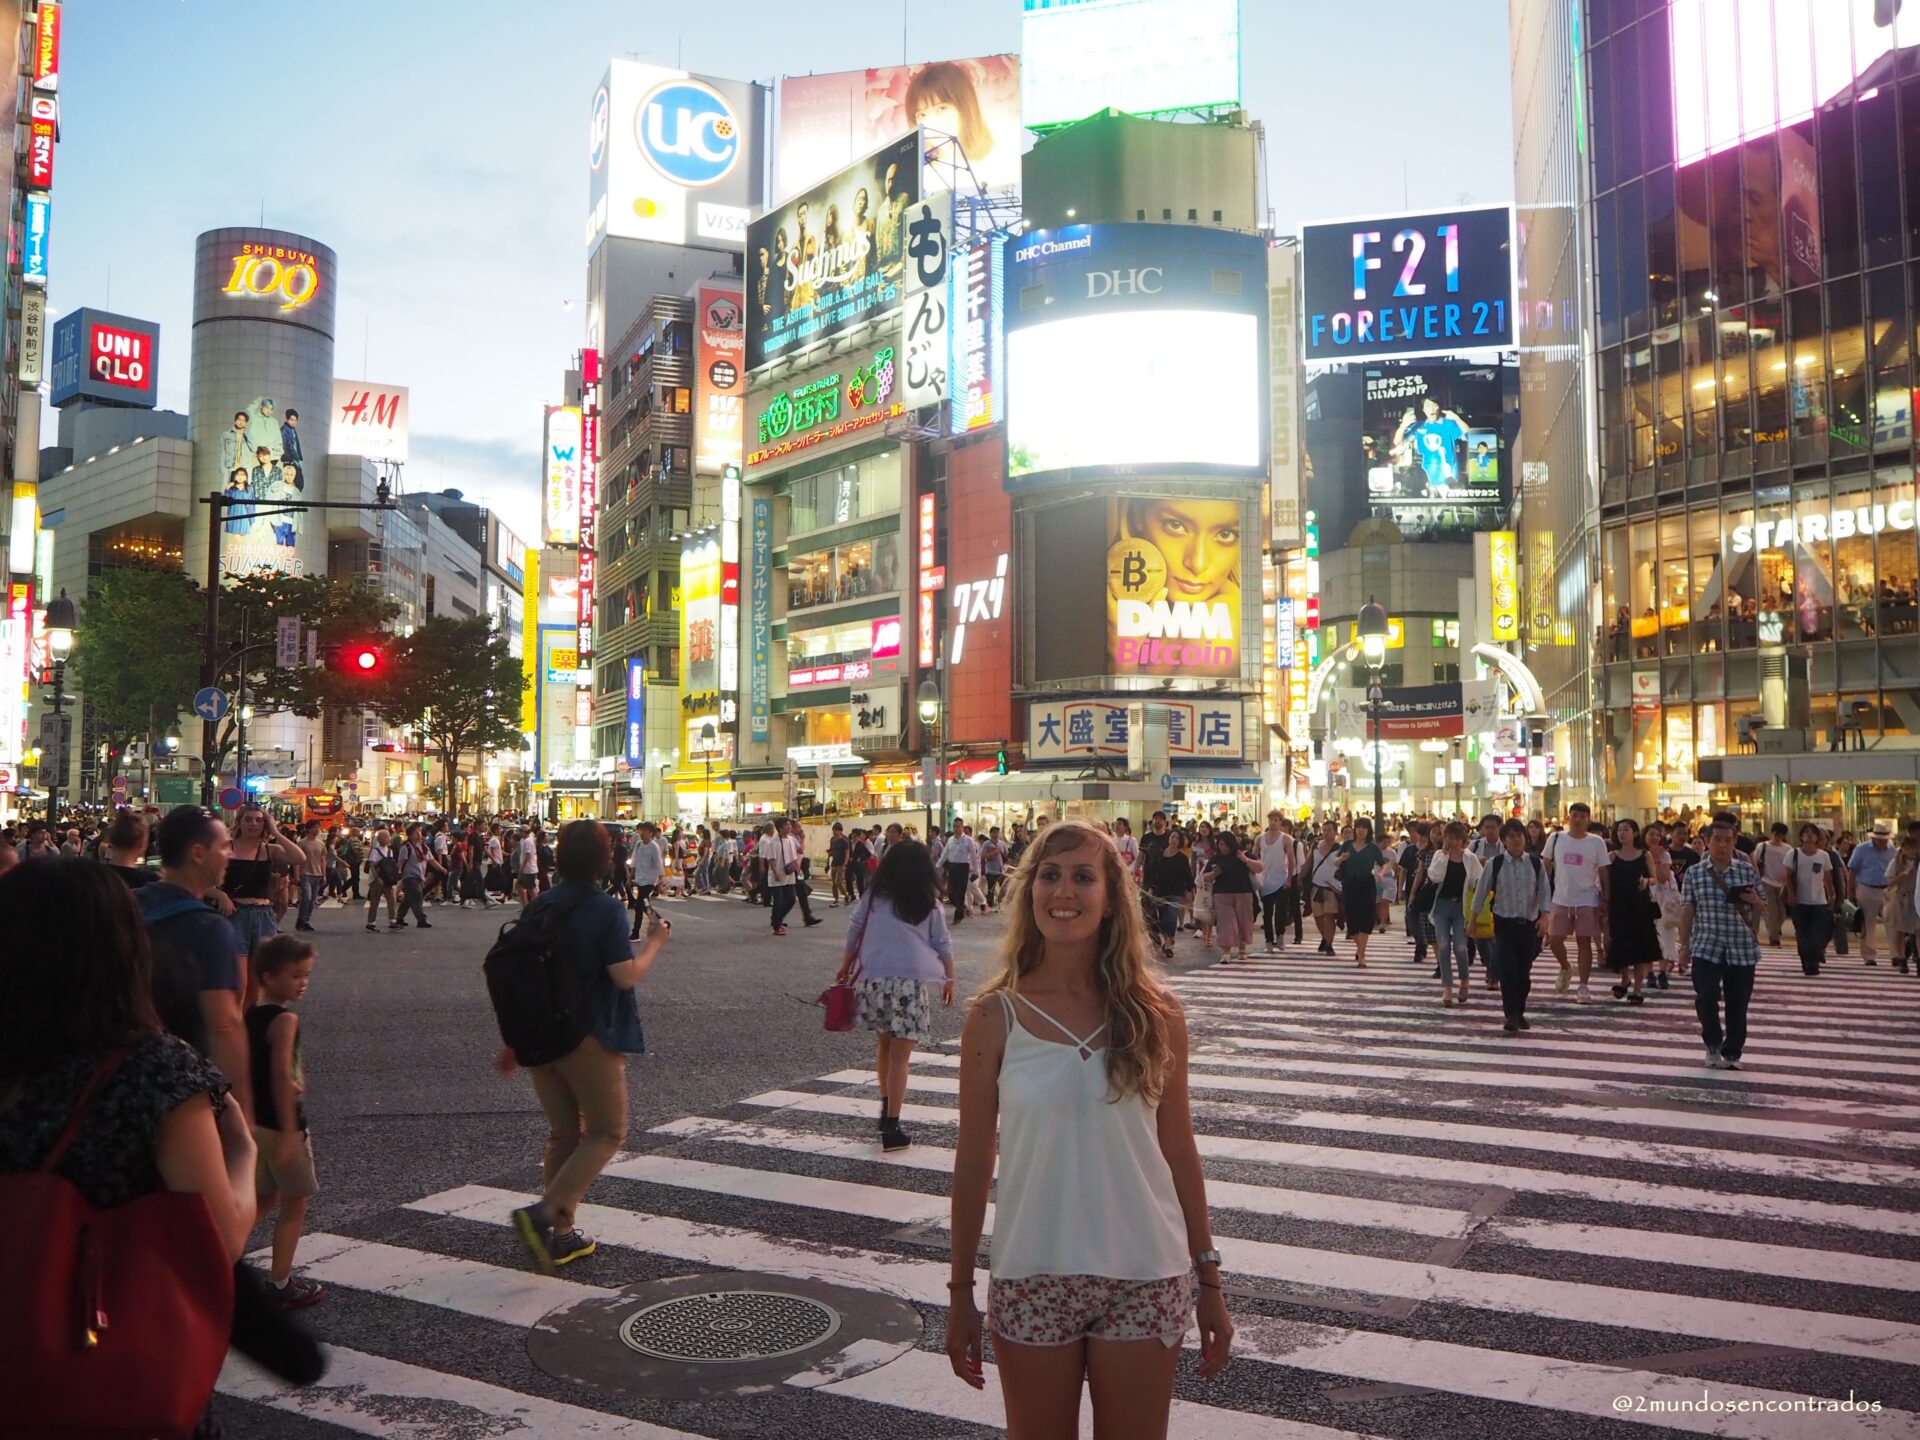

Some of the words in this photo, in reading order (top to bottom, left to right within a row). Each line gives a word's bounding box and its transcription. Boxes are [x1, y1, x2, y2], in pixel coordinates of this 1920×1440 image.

[34, 135, 50, 176] ガスト
[242, 243, 317, 267] SHIBUYA
[784, 230, 871, 291] Suchmos
[1016, 245, 1041, 262] DHC
[1041, 234, 1091, 255] Channel
[1352, 224, 1459, 300] F21
[221, 254, 319, 310] 109
[865, 271, 885, 290] SALE
[908, 204, 947, 396] もんじゃ
[1086, 267, 1163, 299] DHC
[25, 300, 39, 373] 渋谷駅前ビル
[59, 322, 75, 357] THE
[820, 314, 837, 329] LIVE
[966, 250, 986, 416] 三千里薬品
[1312, 304, 1462, 347] FOREVER
[1472, 300, 1504, 334] 21
[97, 332, 140, 359] UNI
[53, 353, 78, 391] PRIME
[96, 356, 143, 382] QLO
[1367, 375, 1423, 391] 監督やっても
[342, 391, 400, 430] H&M
[793, 387, 839, 431] 西村
[1732, 500, 1915, 553] STARBUC
[754, 529, 769, 650] サマーフルーツギフト
[1117, 599, 1233, 639] DMM
[1497, 616, 1512, 628] 4F
[689, 618, 714, 663] 薬
[1117, 638, 1233, 666] Bitcoin
[1038, 710, 1231, 748] 大盛堂書店
